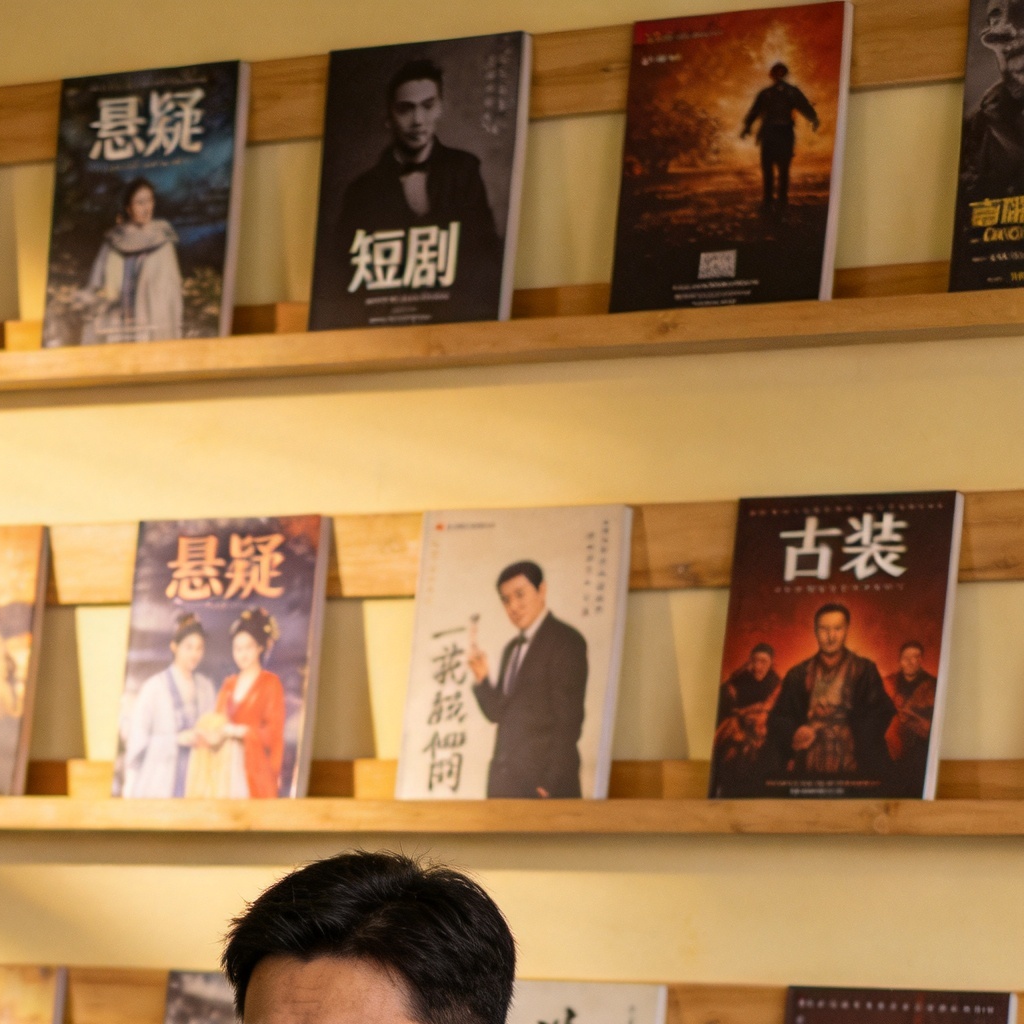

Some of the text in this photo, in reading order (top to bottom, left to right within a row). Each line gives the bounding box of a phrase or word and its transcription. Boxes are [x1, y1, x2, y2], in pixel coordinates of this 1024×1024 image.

[88, 87, 205, 160] 悬疑
[347, 221, 461, 293] 短剧
[165, 533, 286, 600] 悬疑
[779, 512, 908, 581] 古装
